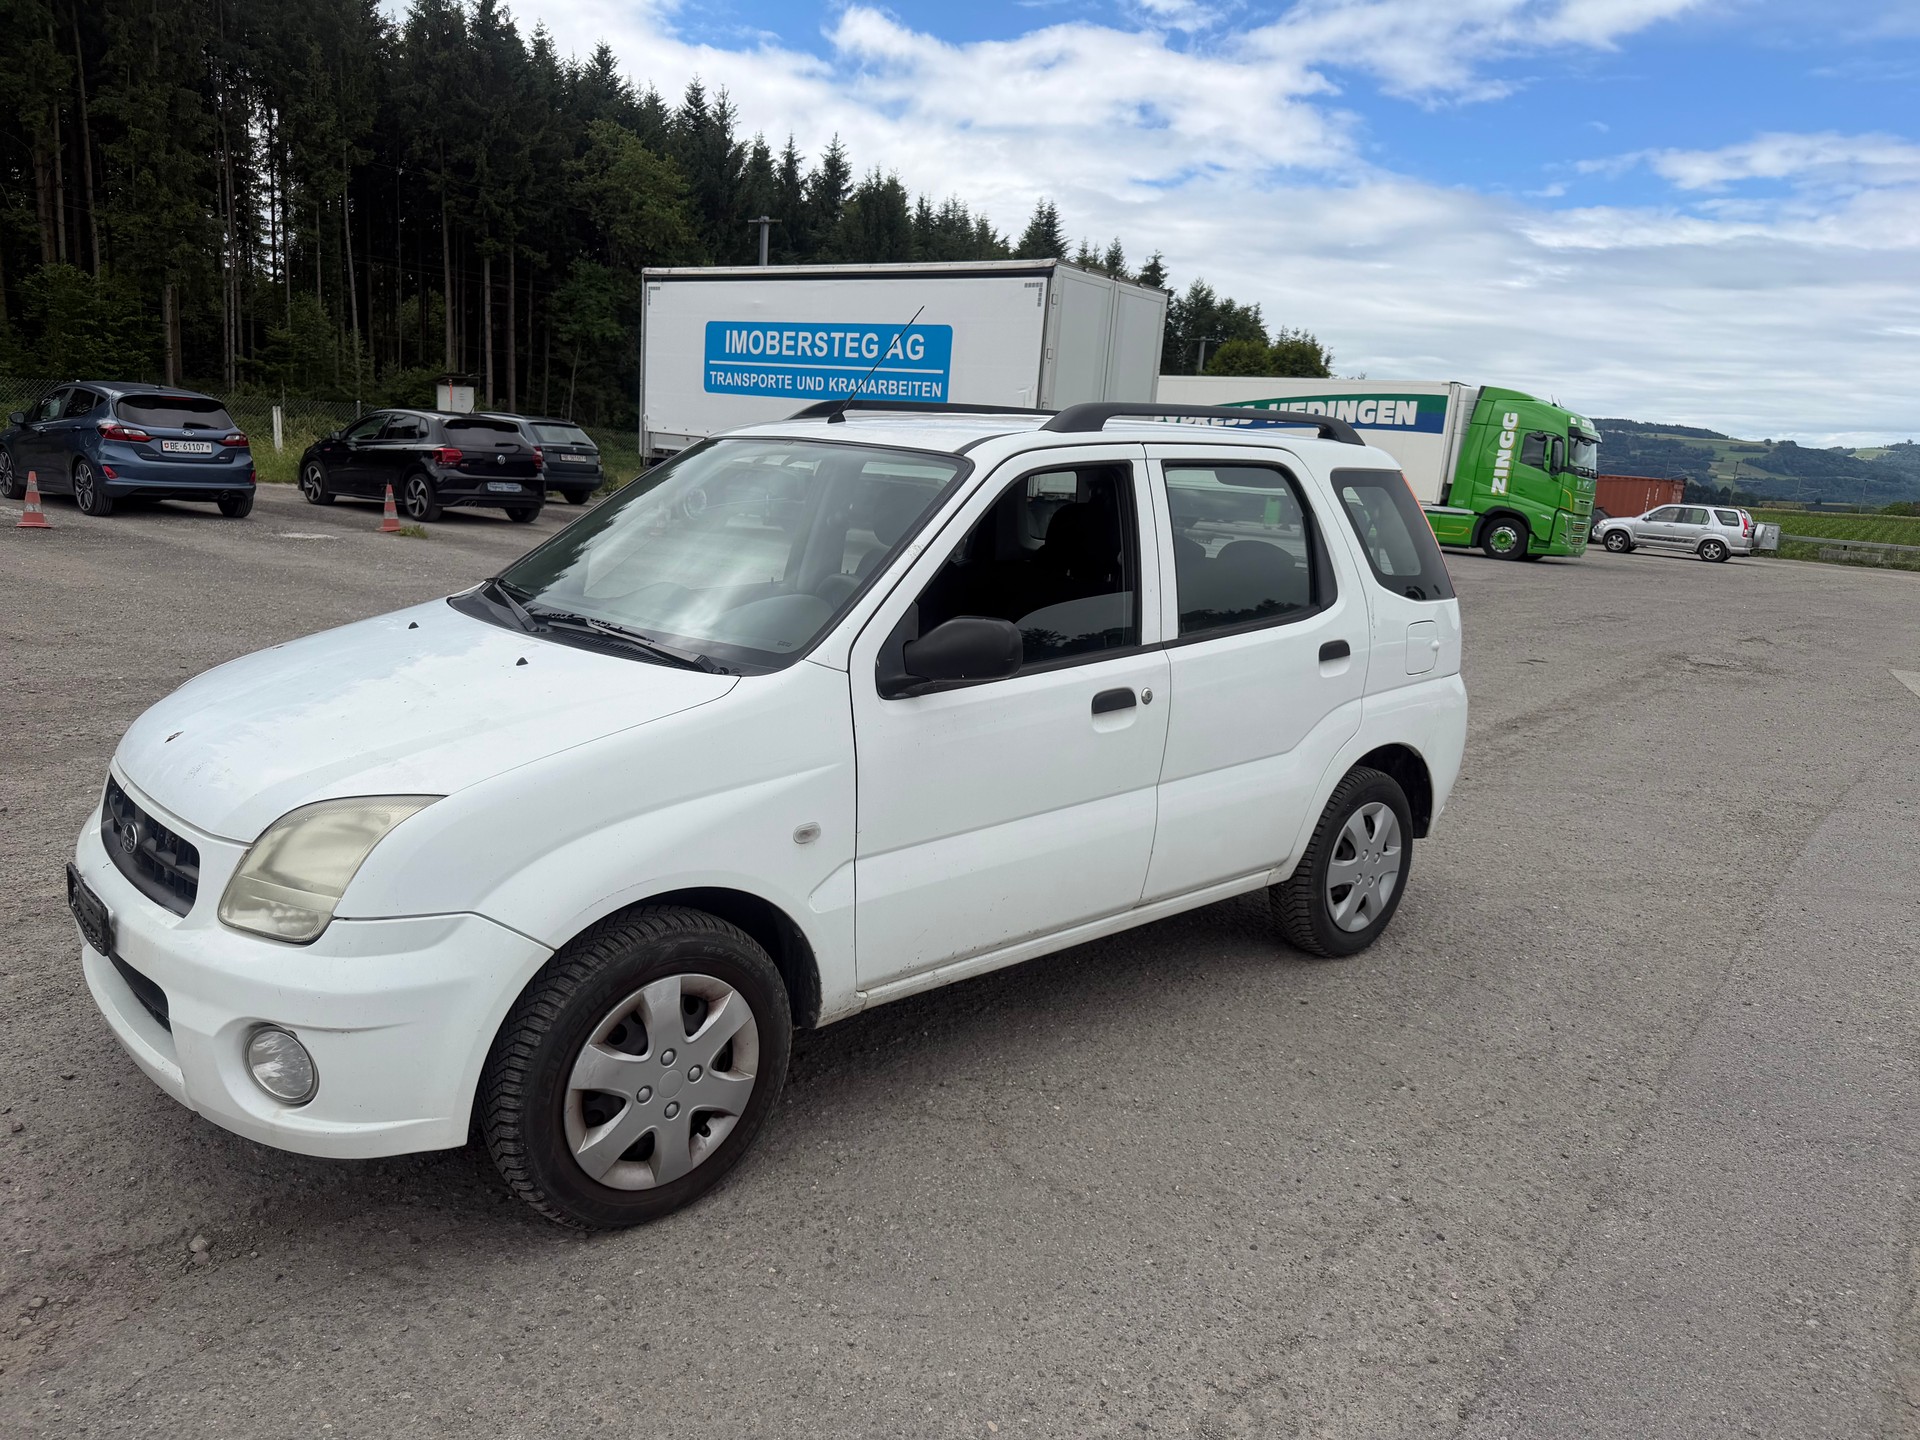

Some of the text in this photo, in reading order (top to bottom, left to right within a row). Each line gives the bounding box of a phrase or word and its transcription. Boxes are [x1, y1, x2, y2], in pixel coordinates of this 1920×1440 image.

[725, 330, 925, 360] IMOBERSTEG AG
[709, 371, 942, 397] TRANSPORTE UND KRANARBEITEN
[1491, 412, 1518, 494] ZINGG
